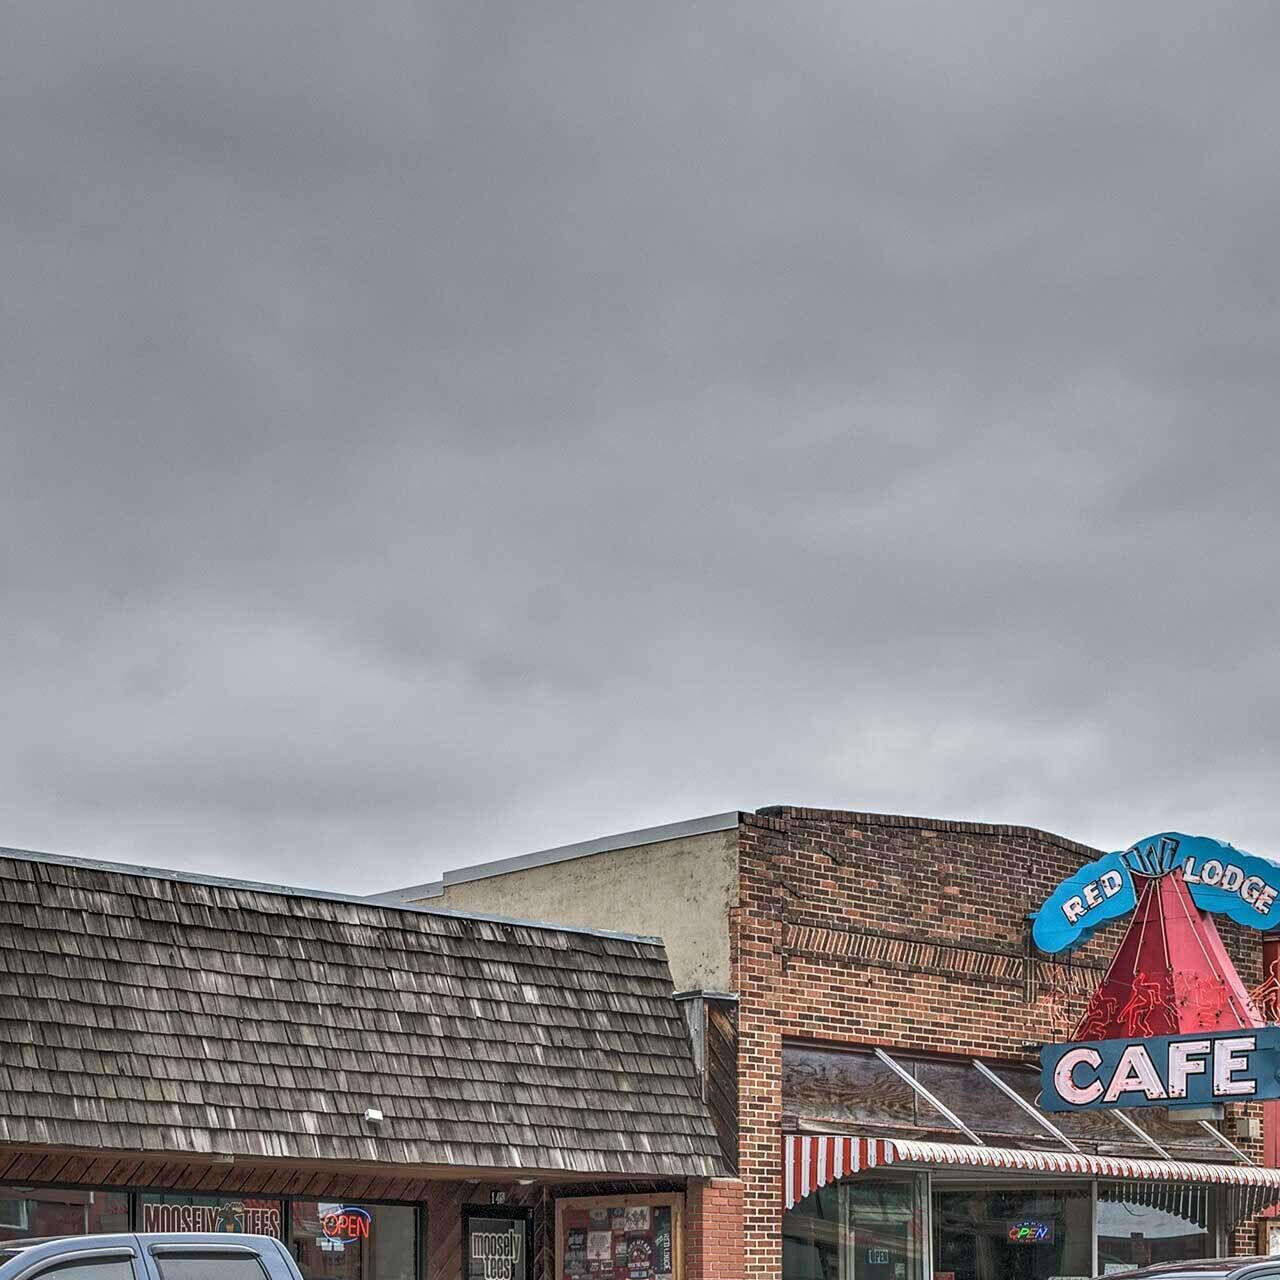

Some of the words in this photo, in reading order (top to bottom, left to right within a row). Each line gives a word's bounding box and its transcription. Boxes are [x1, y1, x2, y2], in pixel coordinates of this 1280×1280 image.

[1062, 869, 1123, 926] RED
[1183, 856, 1279, 915] LODGE
[1054, 1036, 1257, 1104] CAFE
[241, 1208, 281, 1238] TEES
[323, 1214, 370, 1239] OPEN
[1008, 1227, 1049, 1241] OPEN
[472, 1229, 521, 1263] moosely
[483, 1256, 511, 1280] tees
